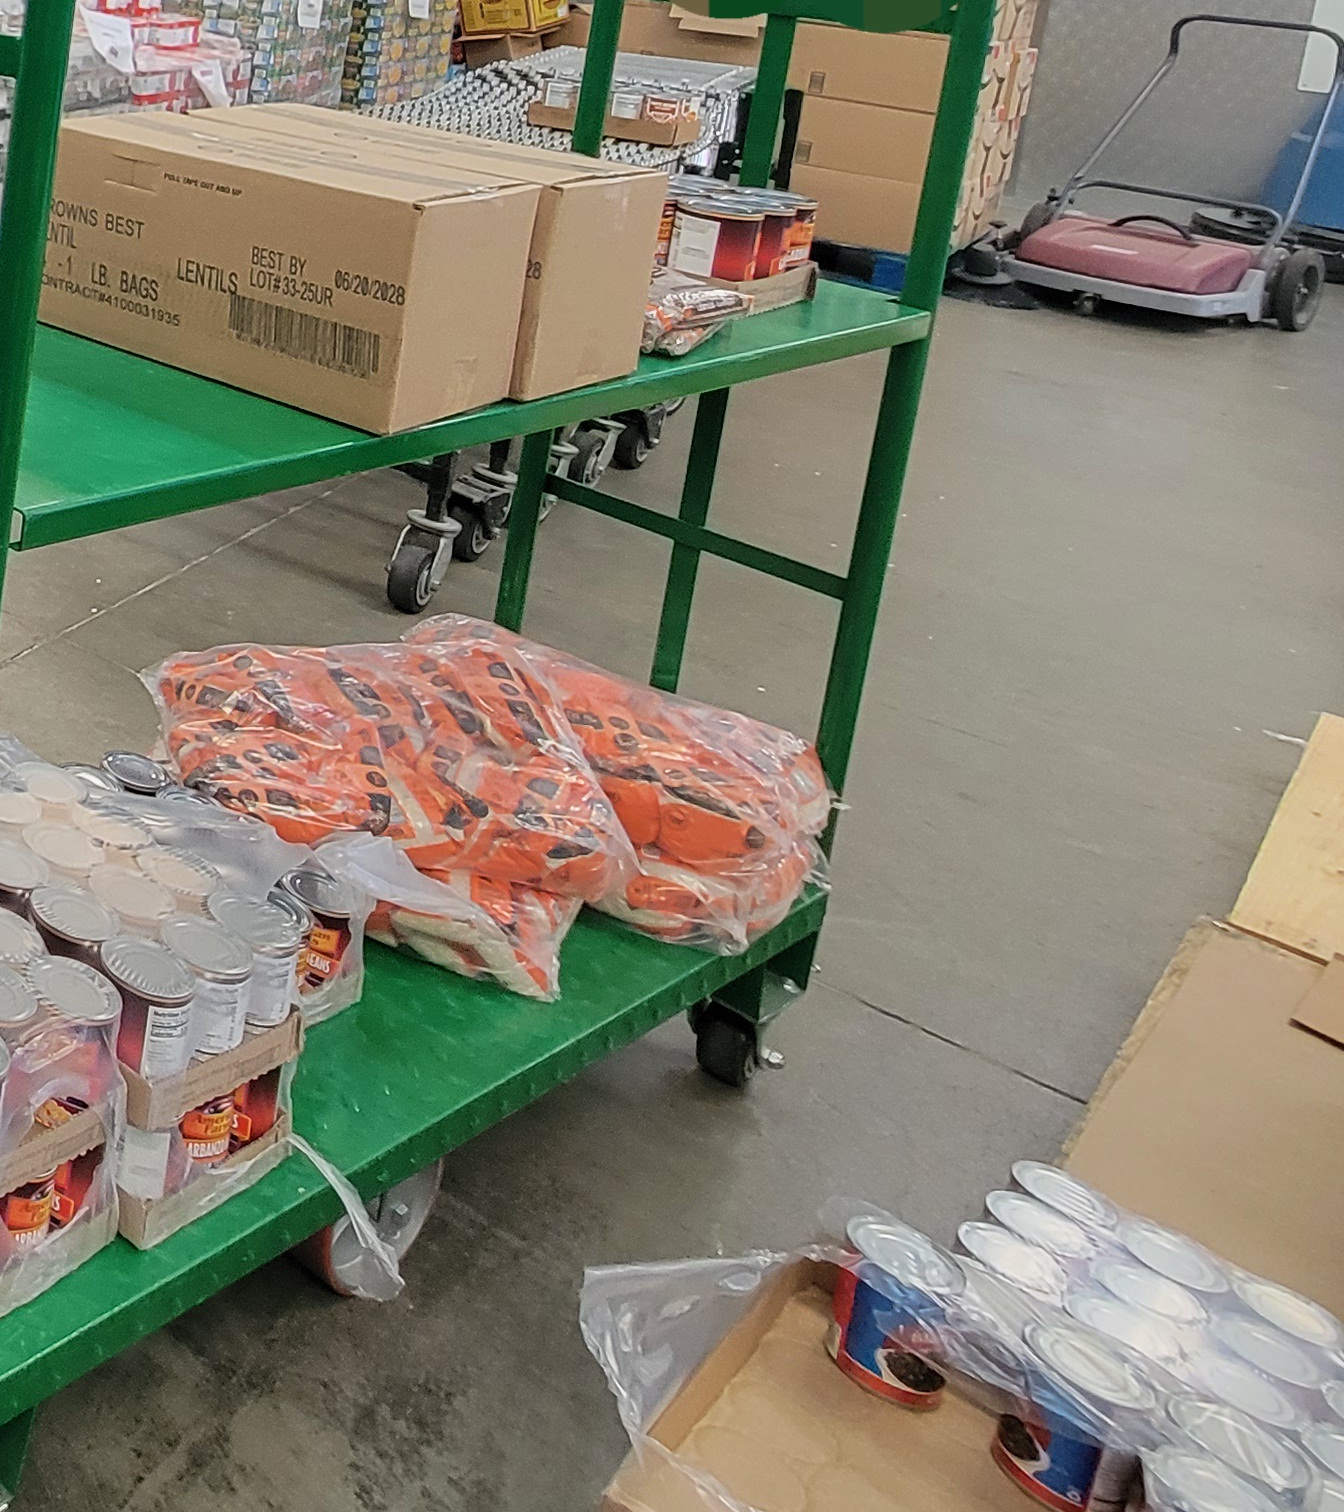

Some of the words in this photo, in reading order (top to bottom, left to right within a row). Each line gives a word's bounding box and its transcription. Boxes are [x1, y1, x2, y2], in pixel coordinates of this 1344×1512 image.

[163, 172, 181, 184] PULL
[199, 180, 214, 190] OUT
[215, 183, 231, 195] AND
[48, 221, 78, 250] NTIL
[50, 197, 99, 229] ROWNS
[105, 212, 146, 240] BEST
[251, 245, 286, 272] BEST
[289, 254, 308, 278] BY
[91, 261, 111, 289] LB.
[119, 270, 161, 303] BAGS
[176, 256, 240, 297] LENTILS
[334, 269, 406, 307] 06/20/2028
[41, 273, 182, 327] ONTRACT#4100031935
[306, 952, 331, 975] EANS
